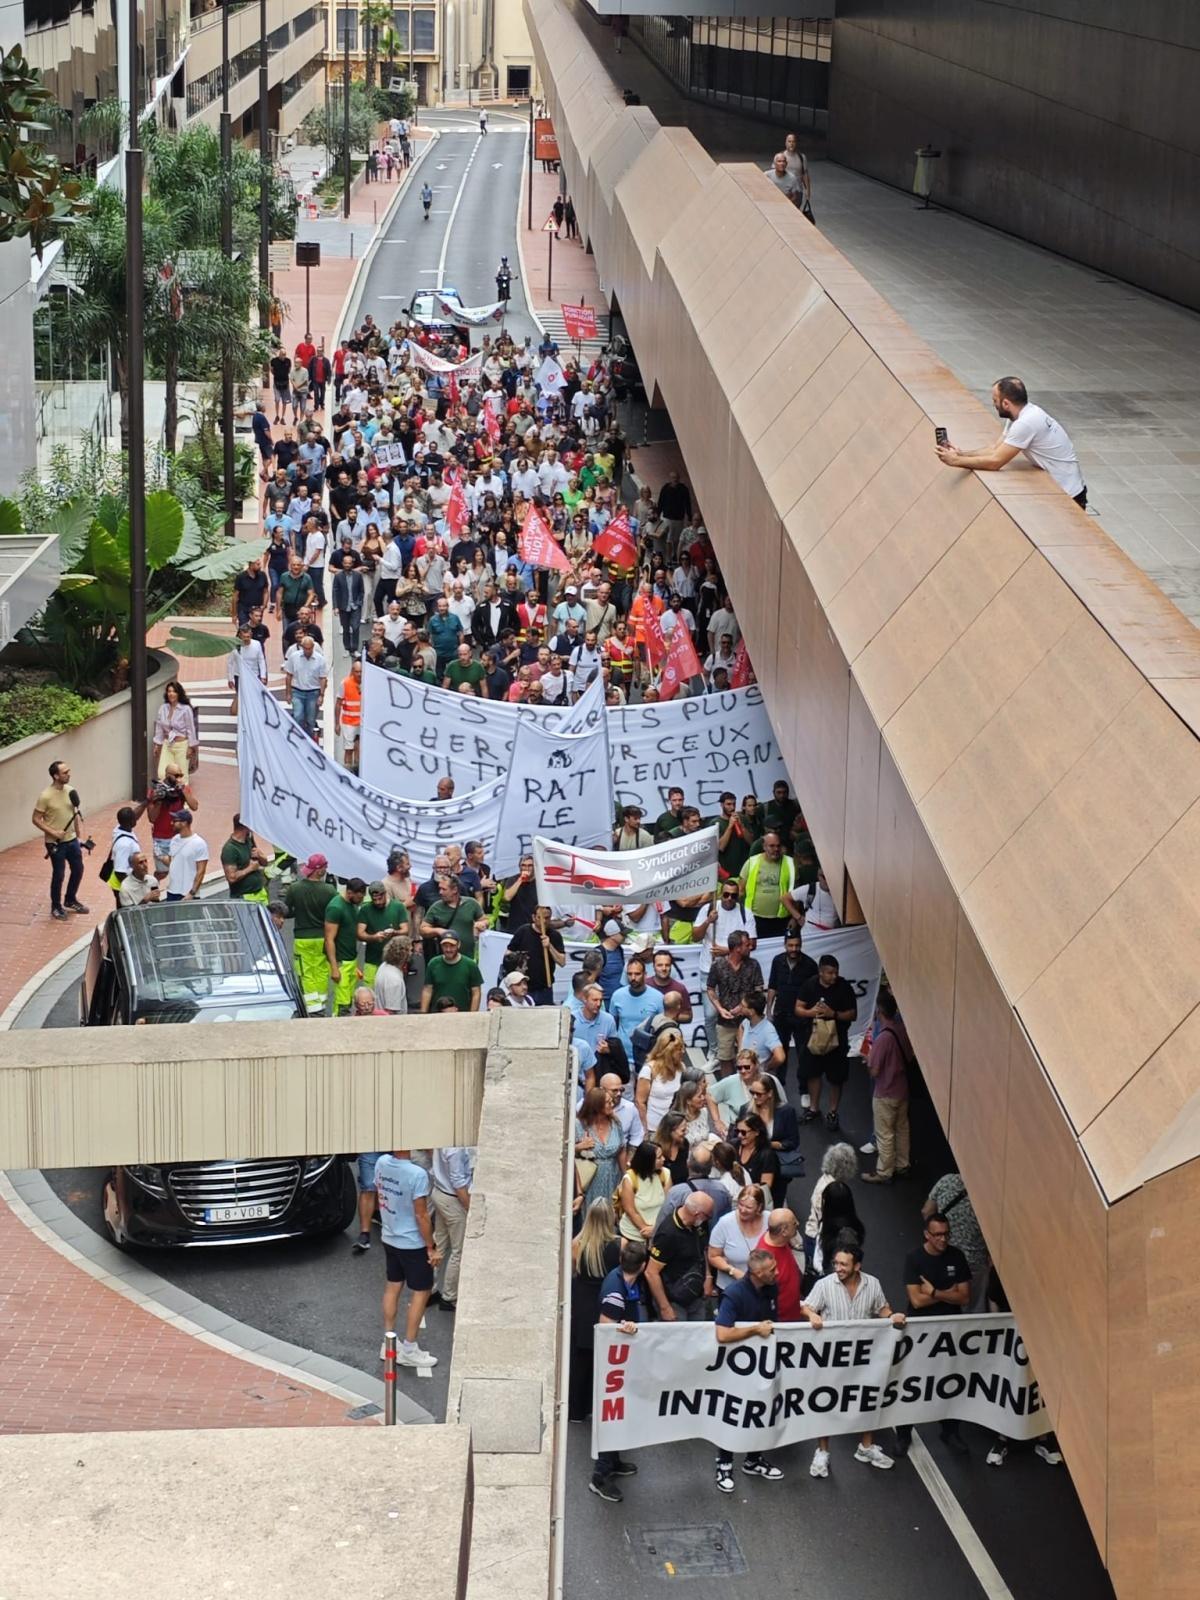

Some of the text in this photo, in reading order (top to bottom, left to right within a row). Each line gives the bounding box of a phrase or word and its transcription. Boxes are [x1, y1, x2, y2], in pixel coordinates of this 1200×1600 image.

[387, 676, 488, 724] DES
[682, 686, 764, 721] PLUS
[657, 722, 750, 755] CEUX
[705, 741, 783, 773] DAN
[524, 768, 596, 804] RAT
[361, 803, 464, 840] UNE
[538, 807, 576, 829] LE
[637, 840, 711, 871] Syndicat des
[652, 861, 701, 882] Autobus
[645, 875, 710, 900] de Monaco
[705, 1338, 874, 1380] JOURNEE
